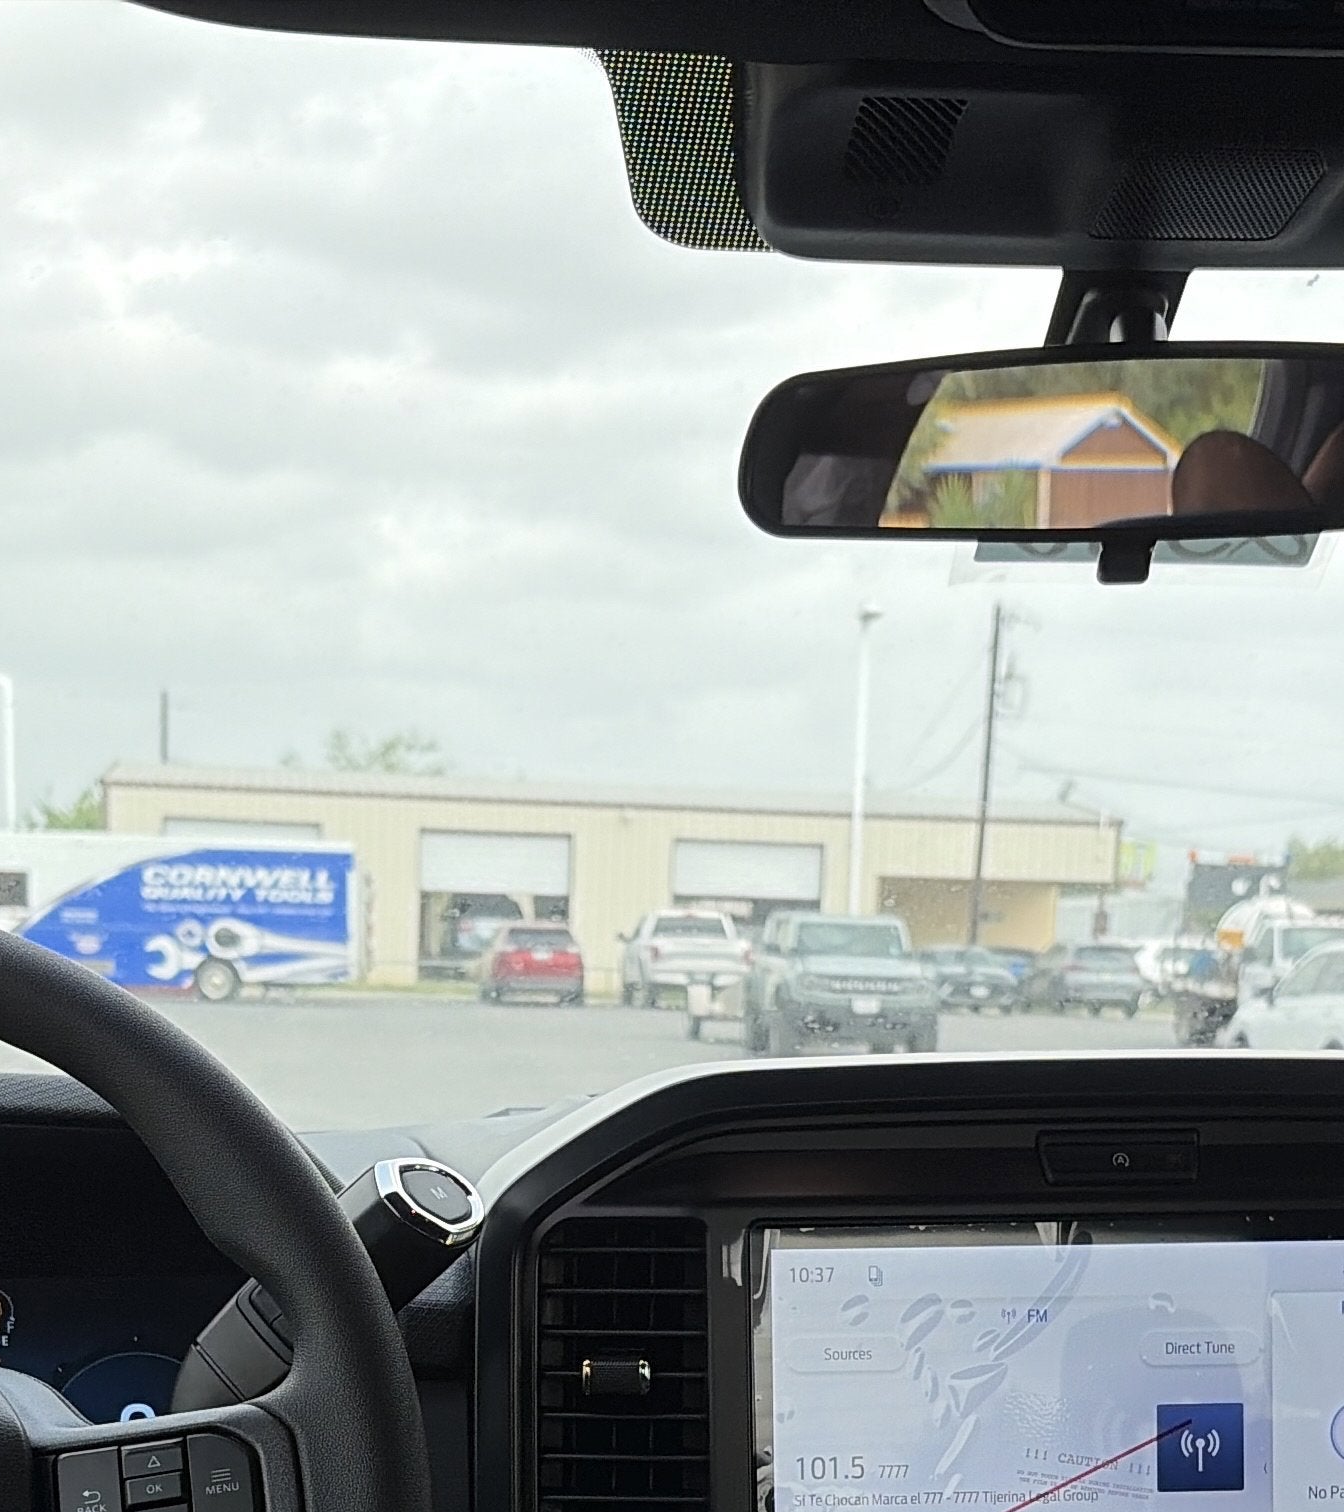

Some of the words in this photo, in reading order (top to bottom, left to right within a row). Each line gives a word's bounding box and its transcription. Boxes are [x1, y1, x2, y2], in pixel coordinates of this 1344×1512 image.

[142, 863, 334, 890] CORNWELL
[789, 1266, 834, 1284] 10:37
[1027, 1309, 1048, 1323] FM
[2, 1335, 9, 1347] E
[1165, 1341, 1201, 1355] Direct
[1204, 1340, 1236, 1354] Tune
[824, 1347, 873, 1361] Sources
[796, 1456, 866, 1480] 101.5
[878, 1463, 910, 1480] 7777
[145, 1484, 163, 1495] OK
[205, 1481, 240, 1495] MENU
[1308, 1484, 1327, 1499] No
[808, 1493, 823, 1507] Te
[825, 1493, 869, 1507] Chocan
[872, 1492, 908, 1506] Marca
[910, 1491, 922, 1505] el
[923, 1491, 944, 1504] 777
[953, 1490, 979, 1504] 7777
[983, 1490, 1026, 1507] Tijerina
[1062, 1488, 1099, 1504] Group
